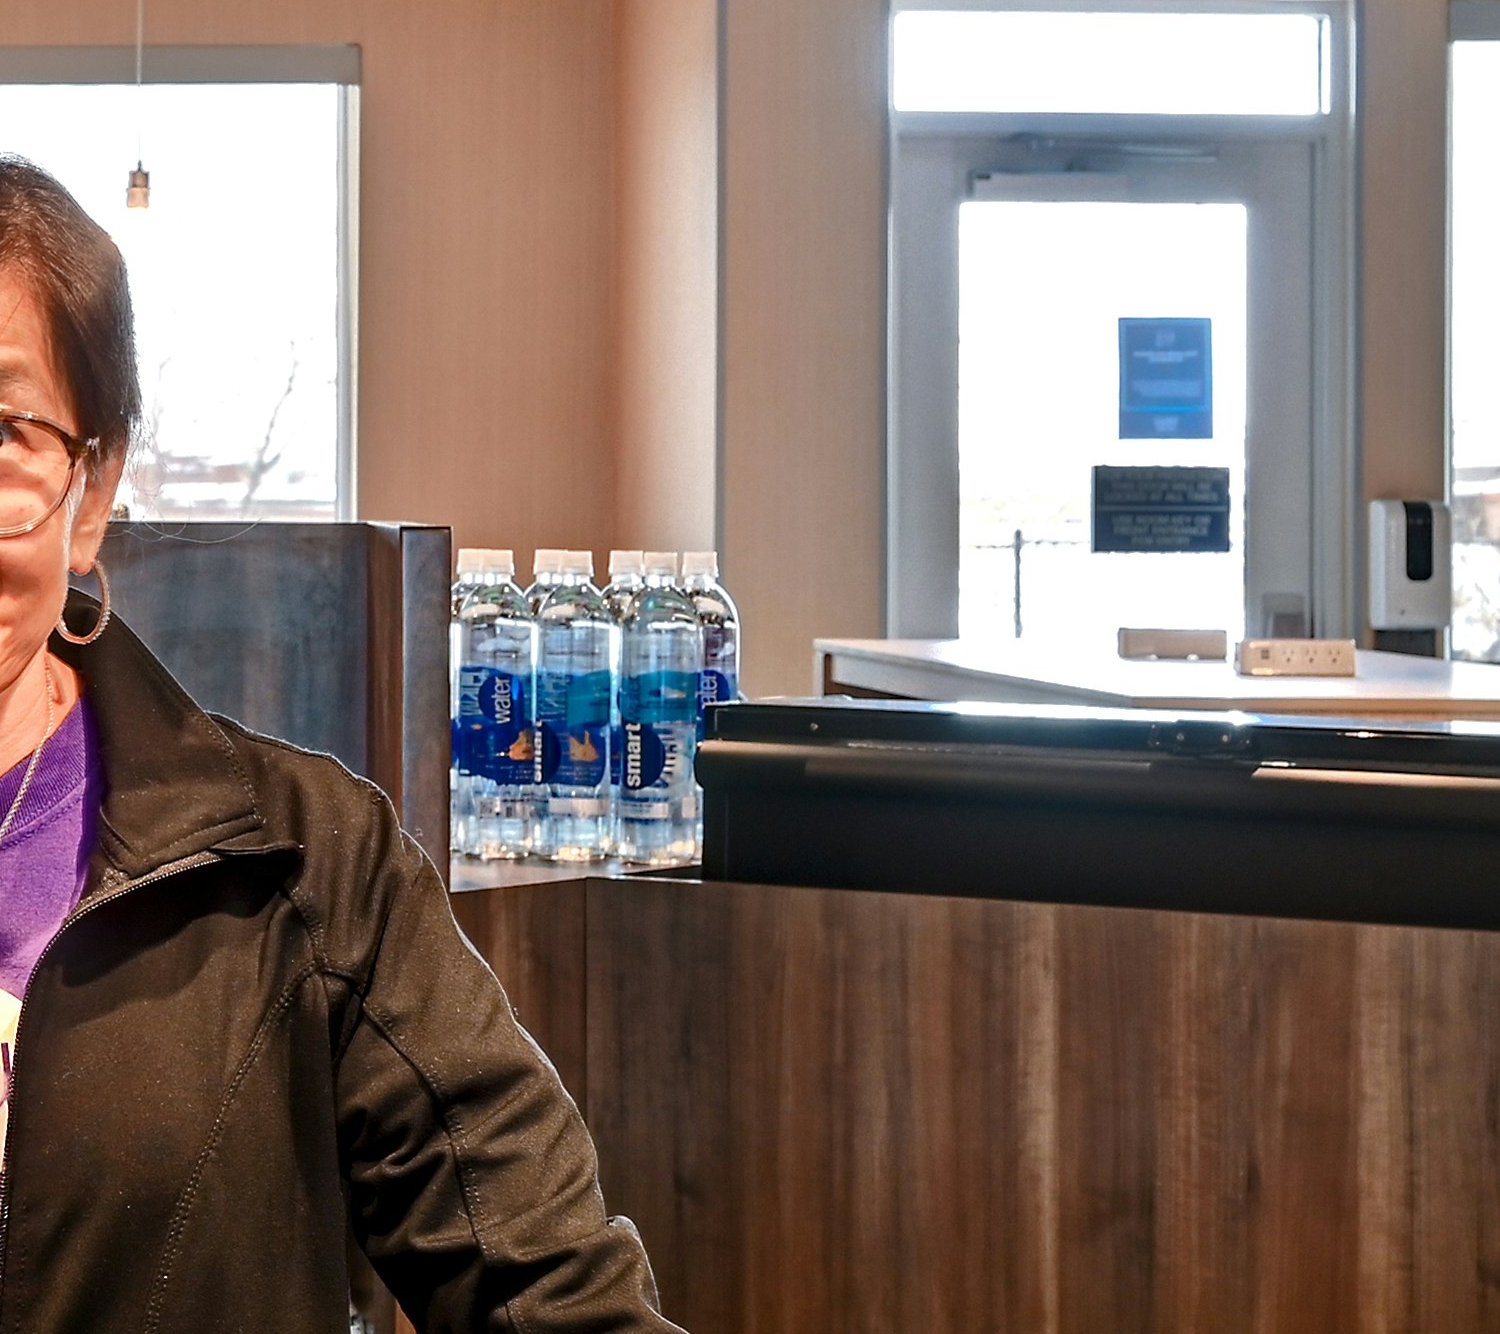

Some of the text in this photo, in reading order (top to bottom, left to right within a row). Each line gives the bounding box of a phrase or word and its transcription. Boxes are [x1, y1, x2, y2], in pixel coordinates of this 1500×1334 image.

[497, 675, 511, 725] water
[695, 676, 717, 709] ater
[625, 723, 641, 787] smart
